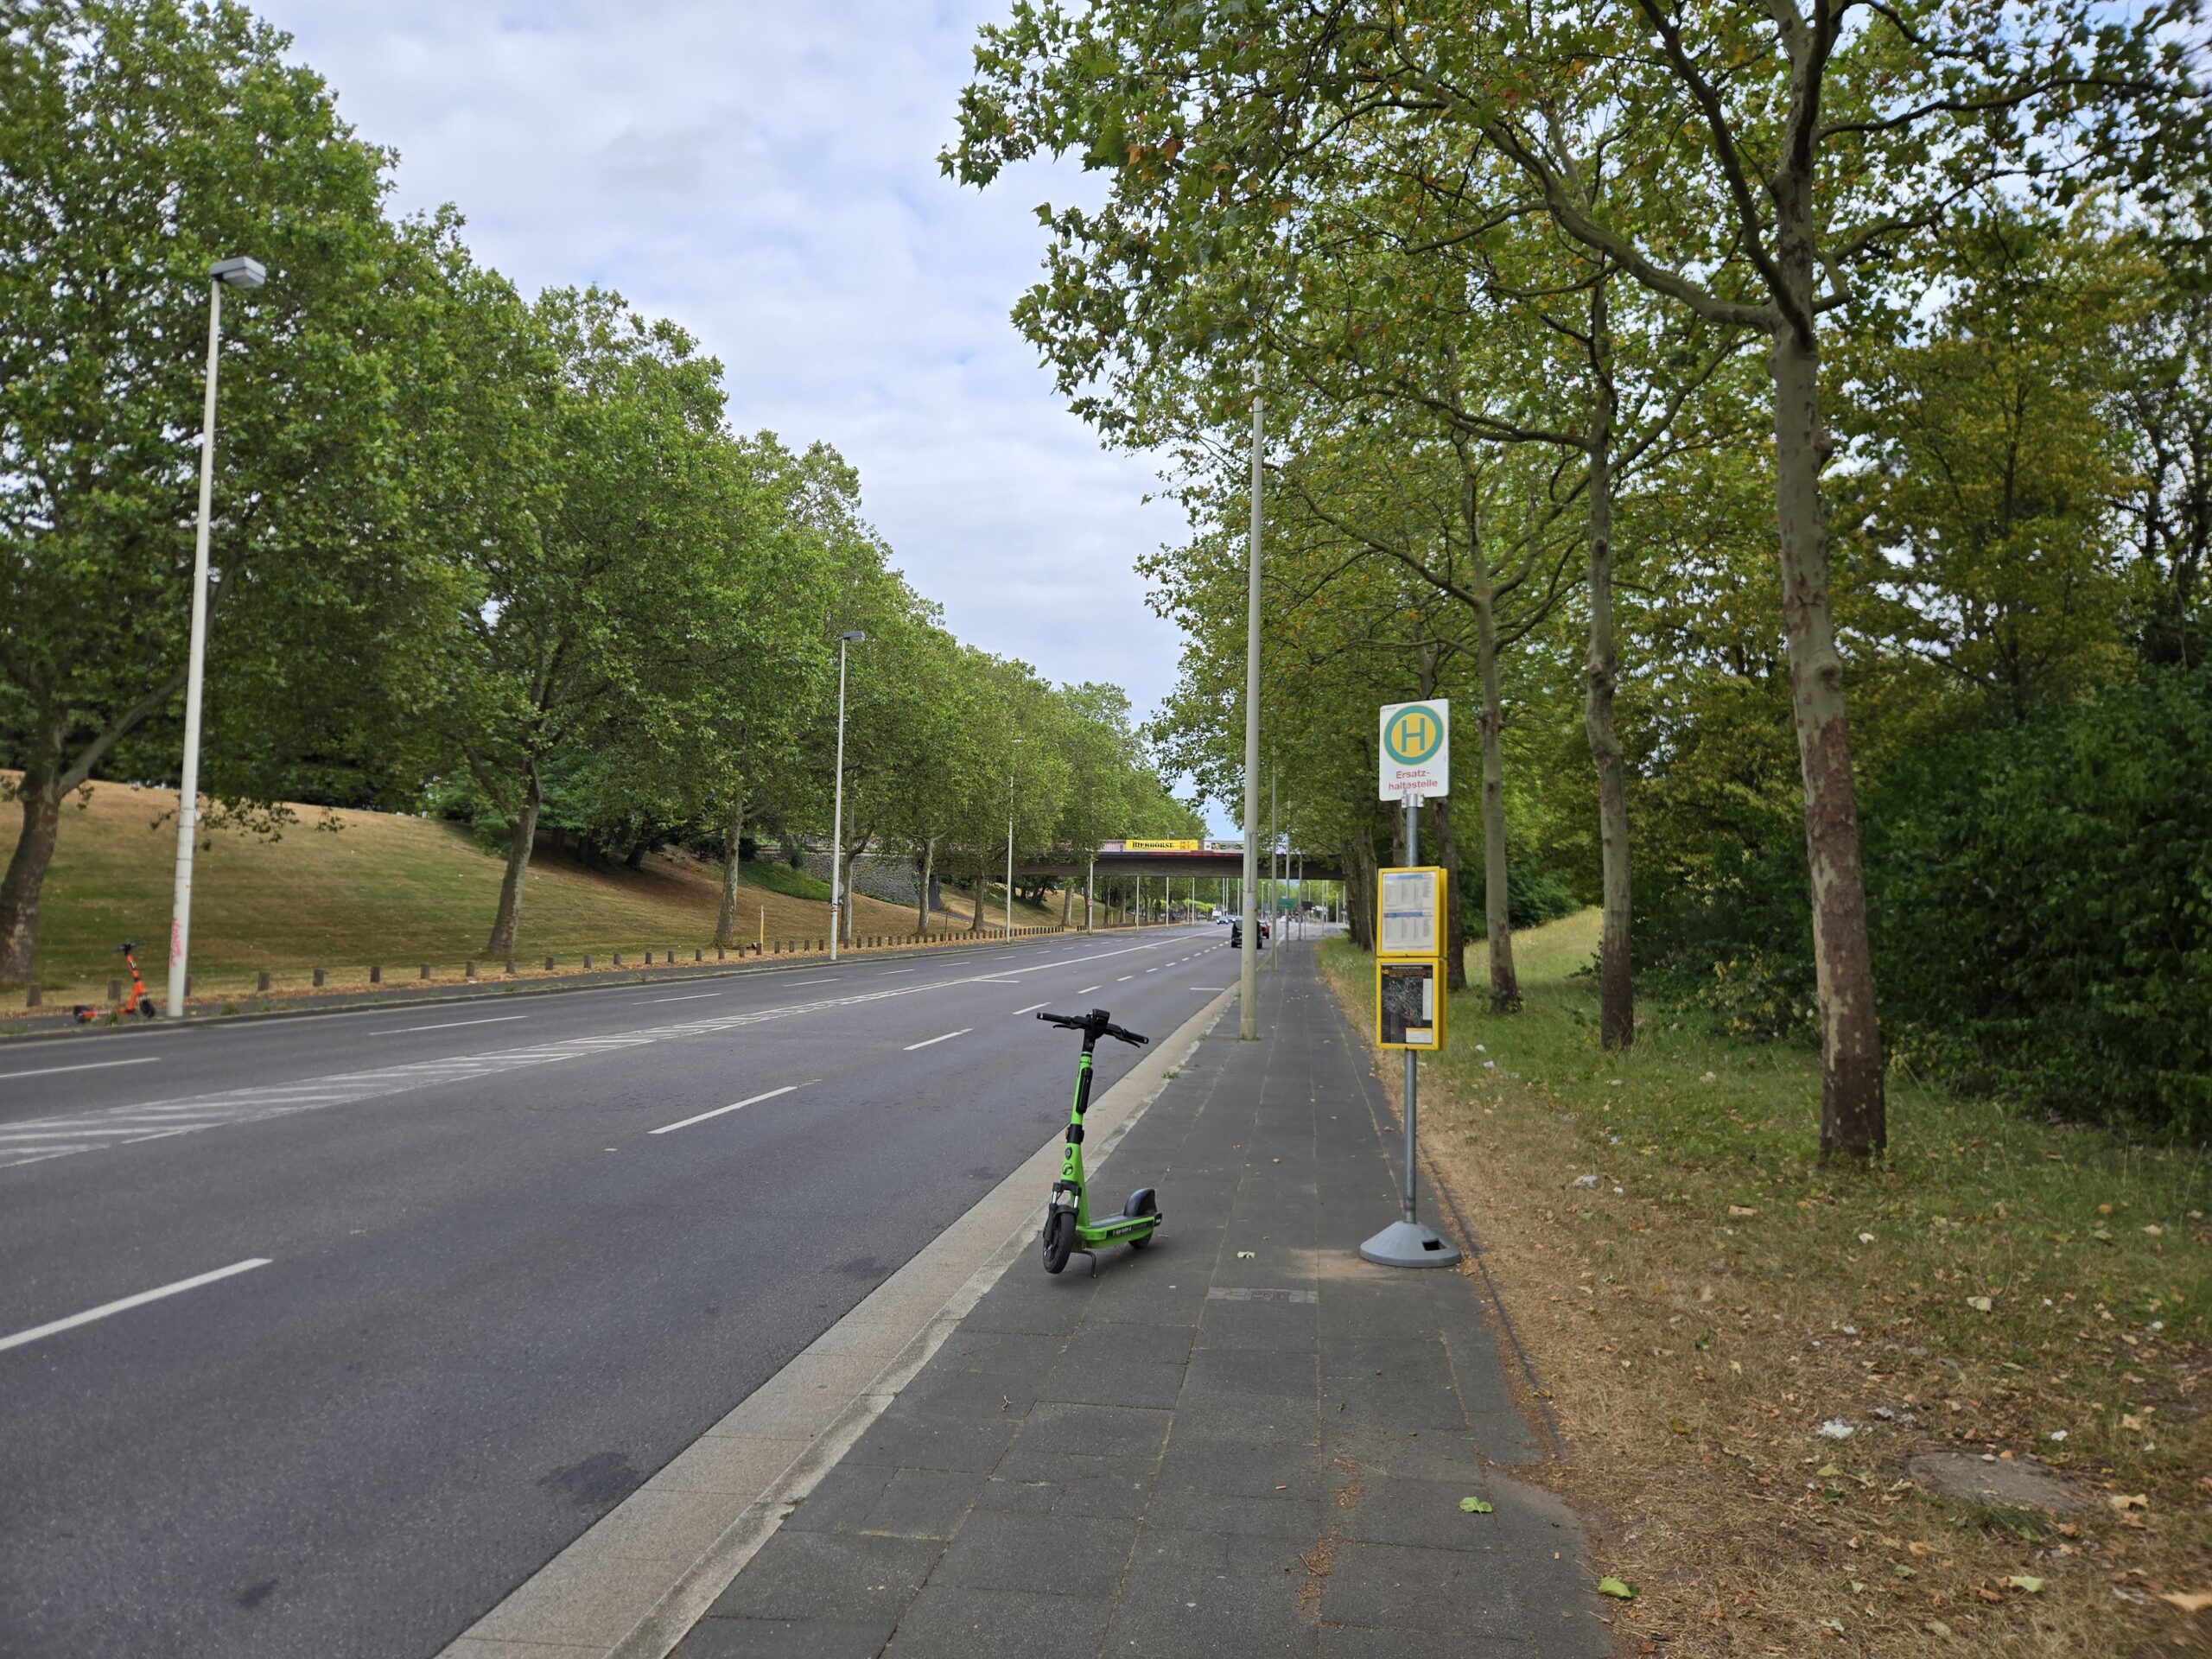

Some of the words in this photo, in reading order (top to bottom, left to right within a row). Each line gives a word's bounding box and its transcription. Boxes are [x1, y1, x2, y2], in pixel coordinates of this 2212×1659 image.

[1402, 718, 1425, 752] H
[1396, 769, 1430, 779] Ersatz-
[1389, 779, 1438, 791] haltestelle
